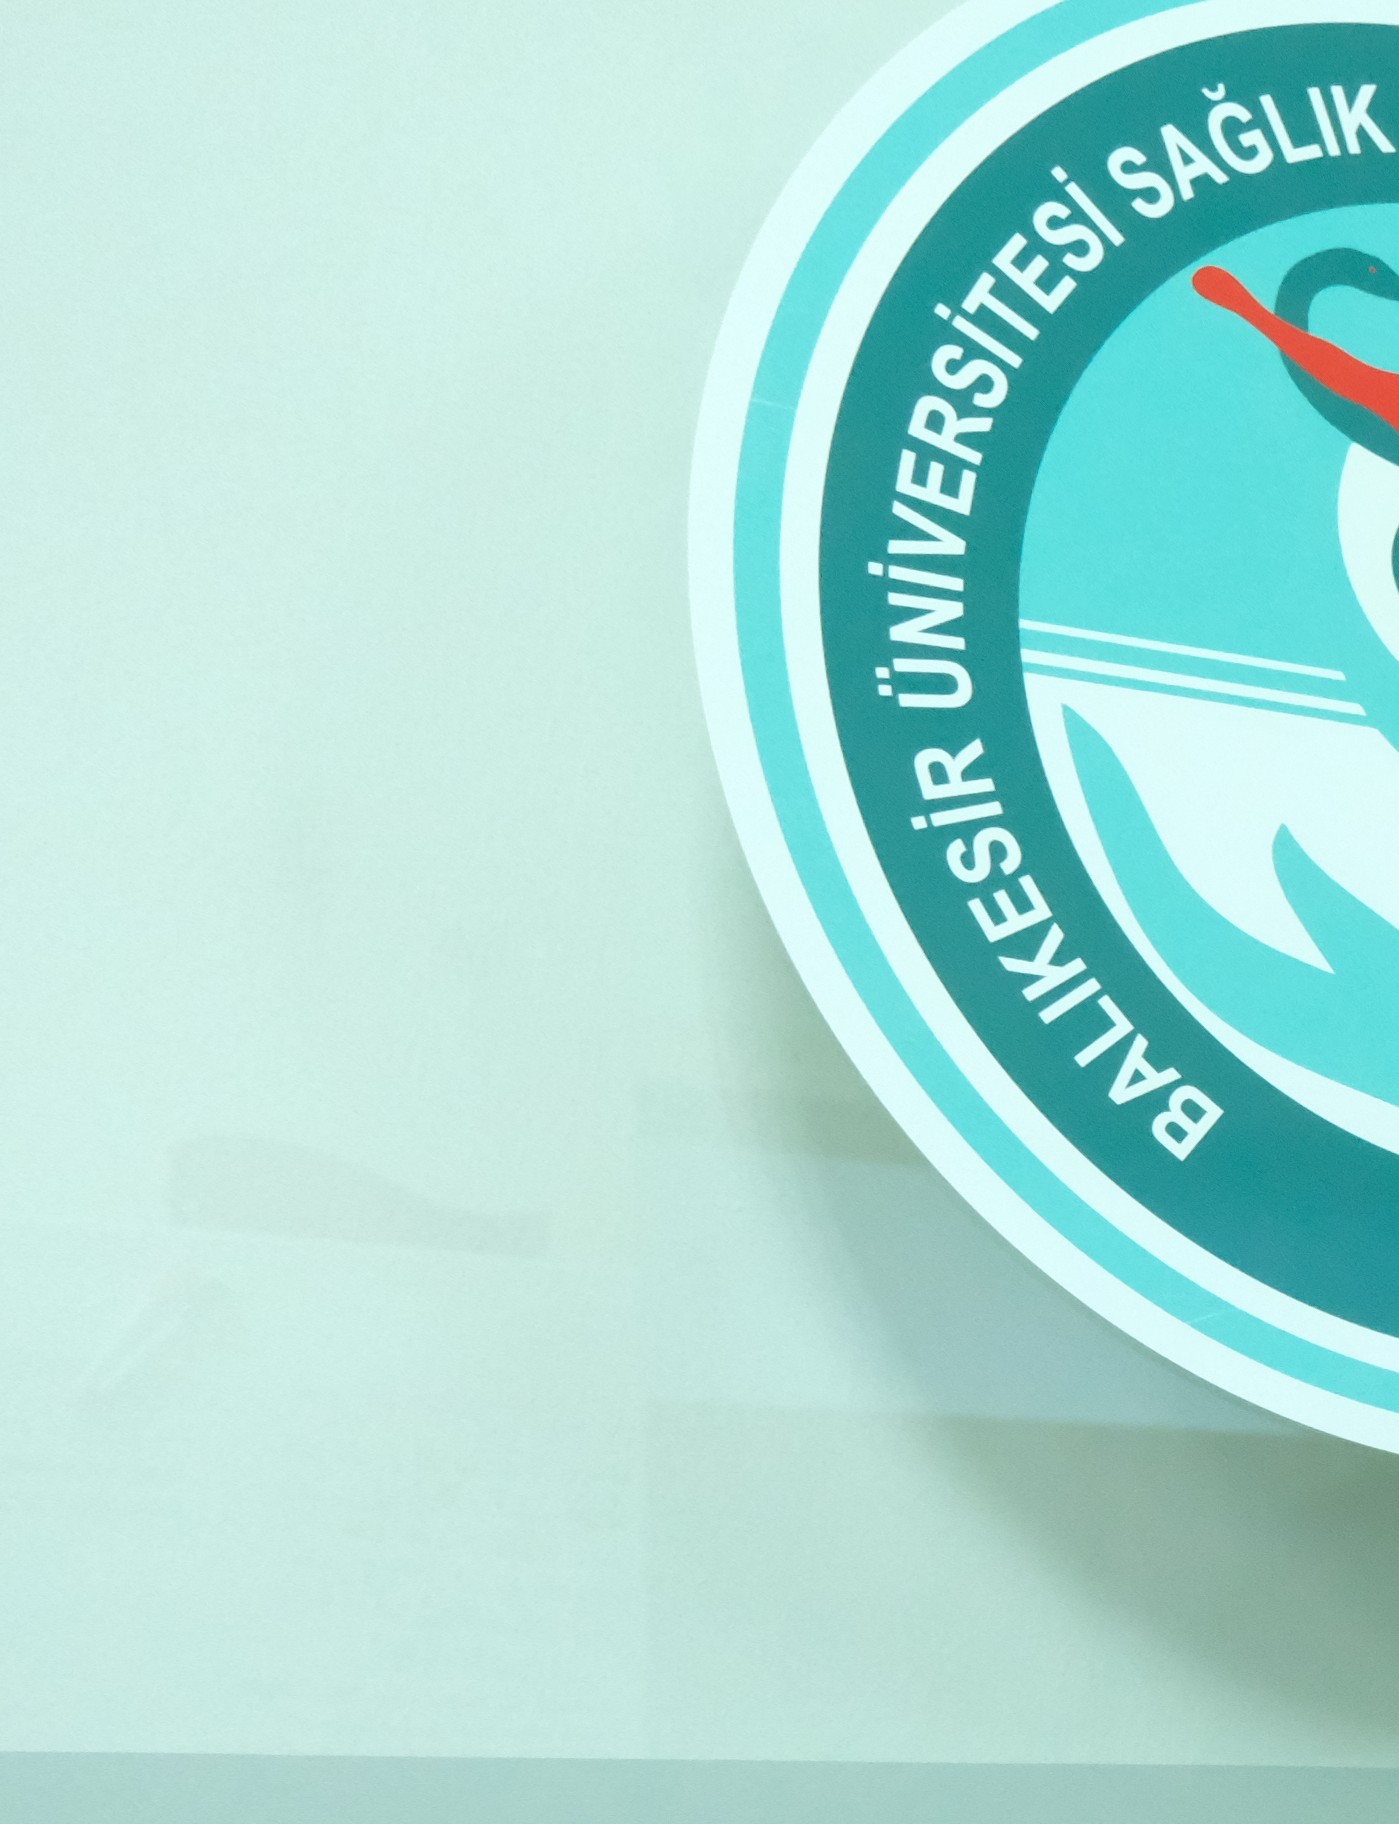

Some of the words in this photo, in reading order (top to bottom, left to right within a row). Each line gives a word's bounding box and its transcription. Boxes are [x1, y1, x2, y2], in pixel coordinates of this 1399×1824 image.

[1107, 83, 1397, 219] SAĞLIK
[867, 165, 1125, 709] ÜNİVERSİTESİ
[910, 738, 1225, 1162] BALIKESİR
